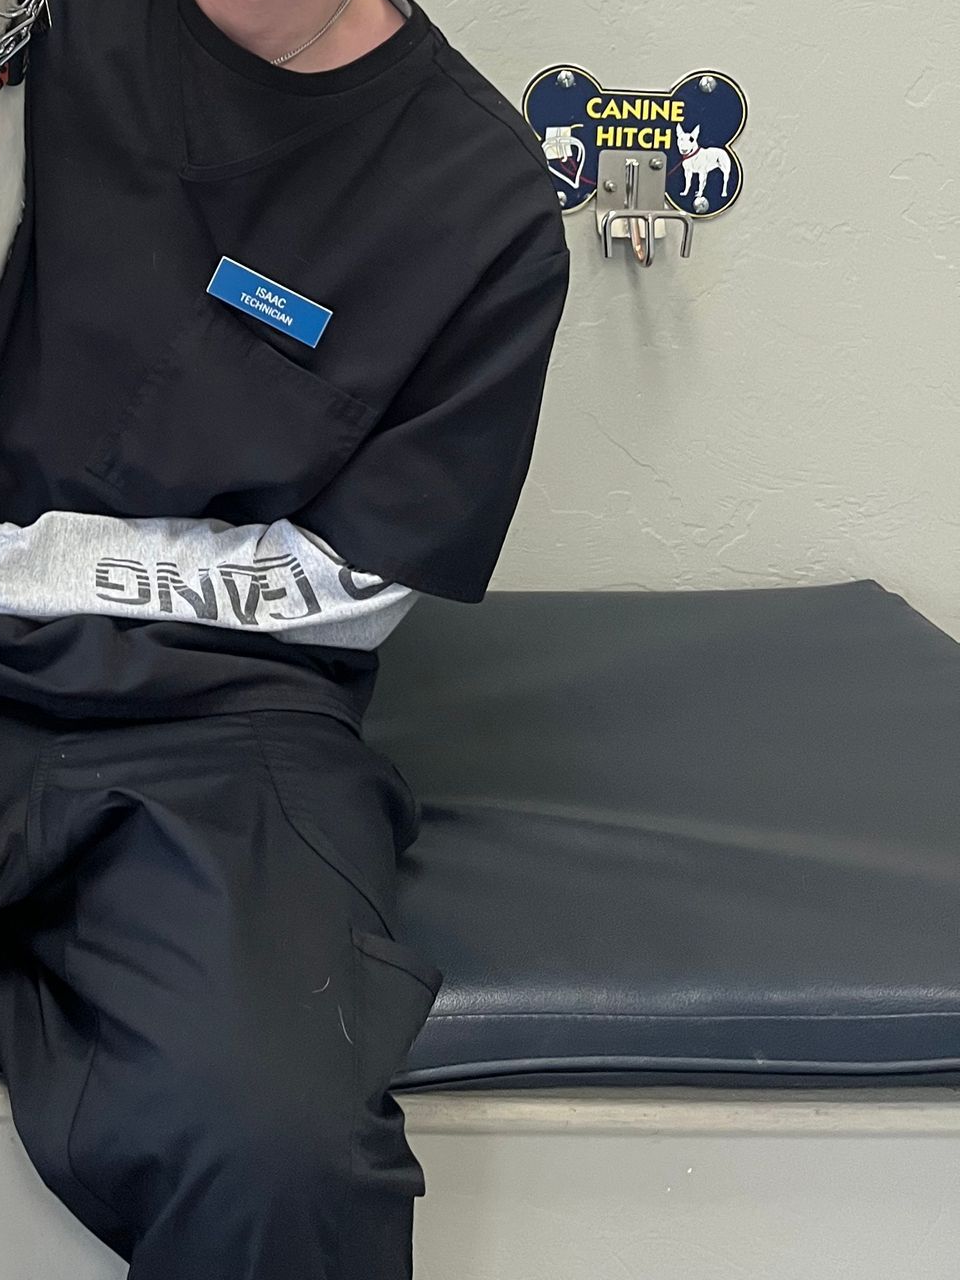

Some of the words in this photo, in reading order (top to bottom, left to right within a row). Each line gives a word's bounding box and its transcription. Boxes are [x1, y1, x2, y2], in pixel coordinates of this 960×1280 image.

[586, 97, 685, 122] CANINE
[596, 125, 672, 150] HITCH
[240, 292, 294, 327] TECHNICIAN
[255, 286, 287, 310] ISAAC
